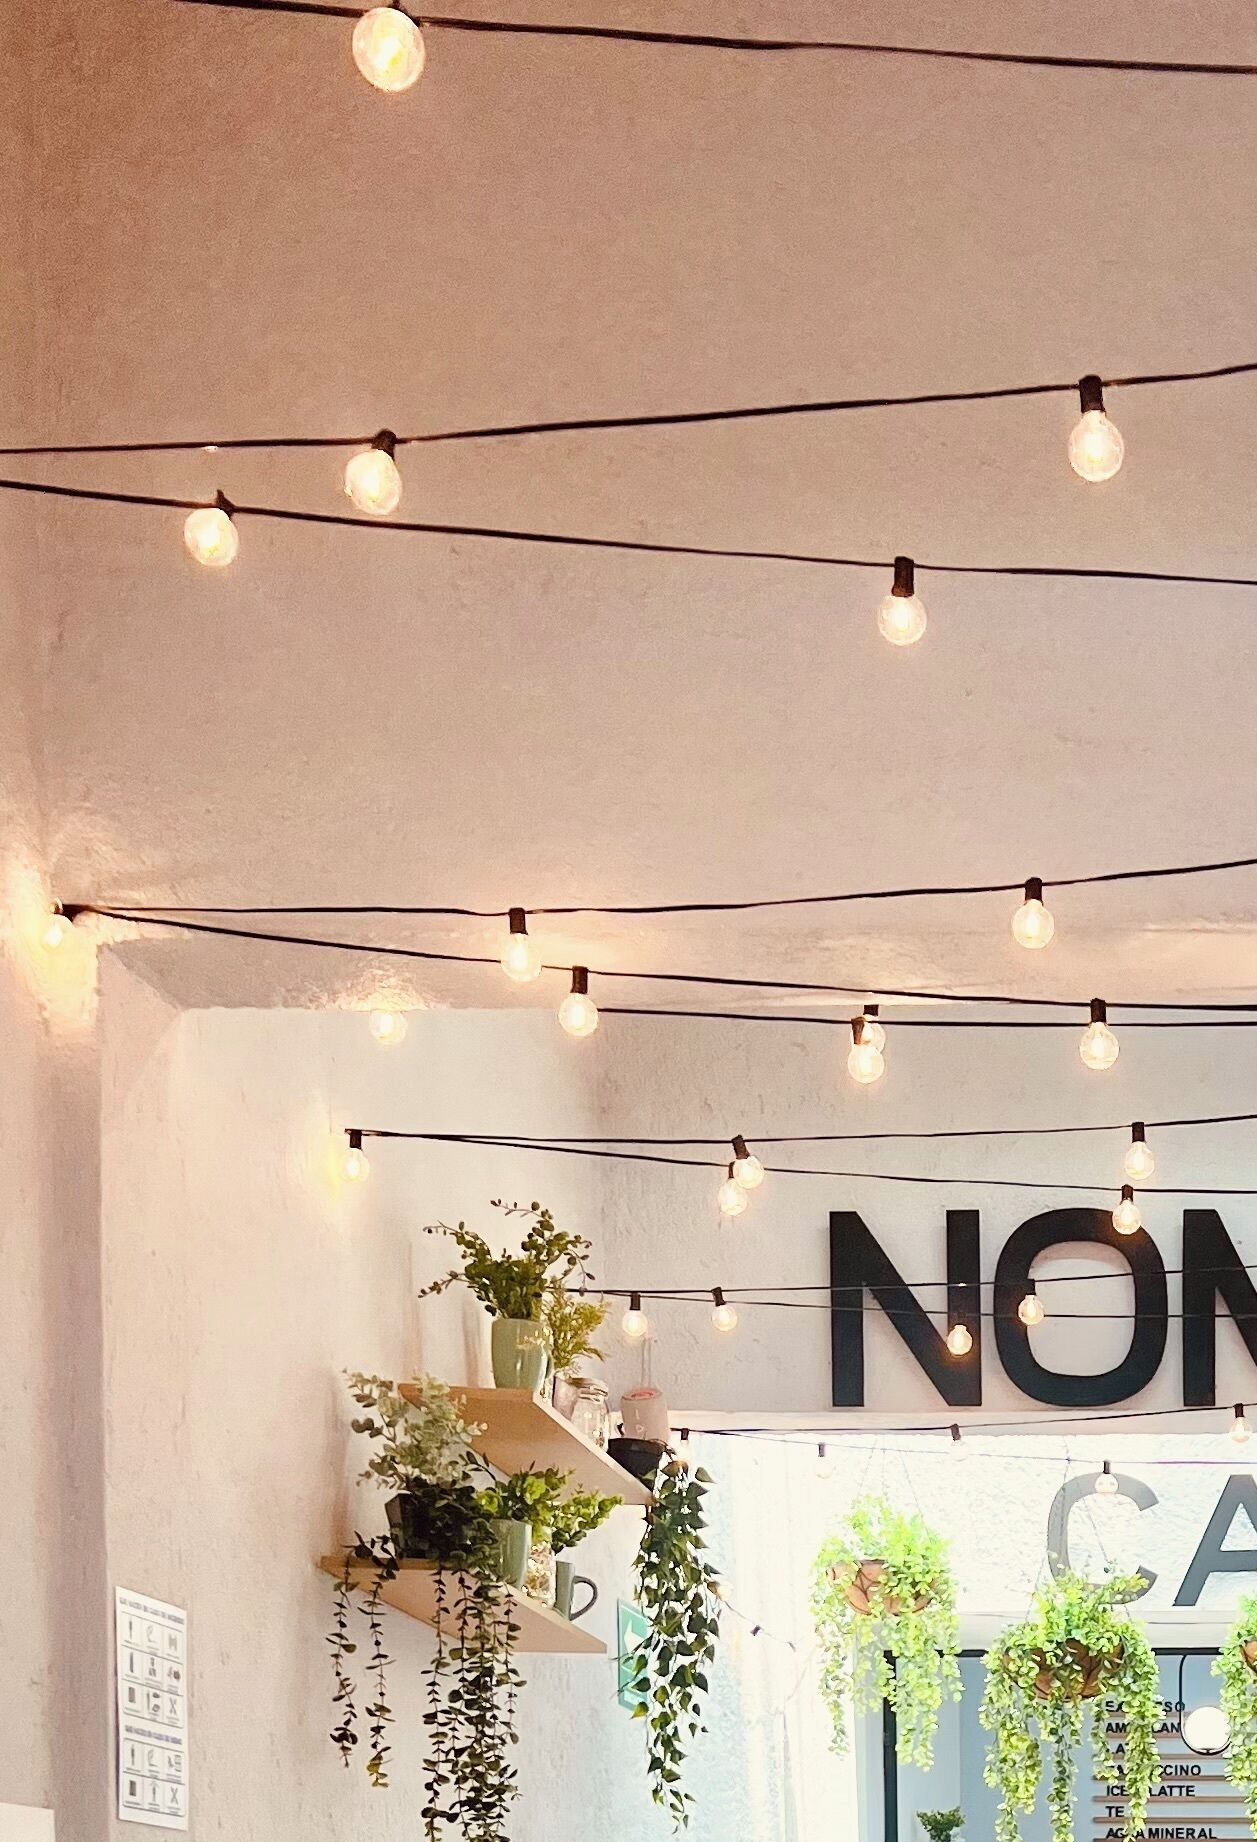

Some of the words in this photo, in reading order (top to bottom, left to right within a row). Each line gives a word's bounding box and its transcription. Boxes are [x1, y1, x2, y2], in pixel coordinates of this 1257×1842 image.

[1149, 1785, 1196, 1797] LATTE
[1106, 1806, 1124, 1818] TE
[1106, 1827, 1145, 1839] AGA
[1148, 1828, 1218, 1839] MINERAL
